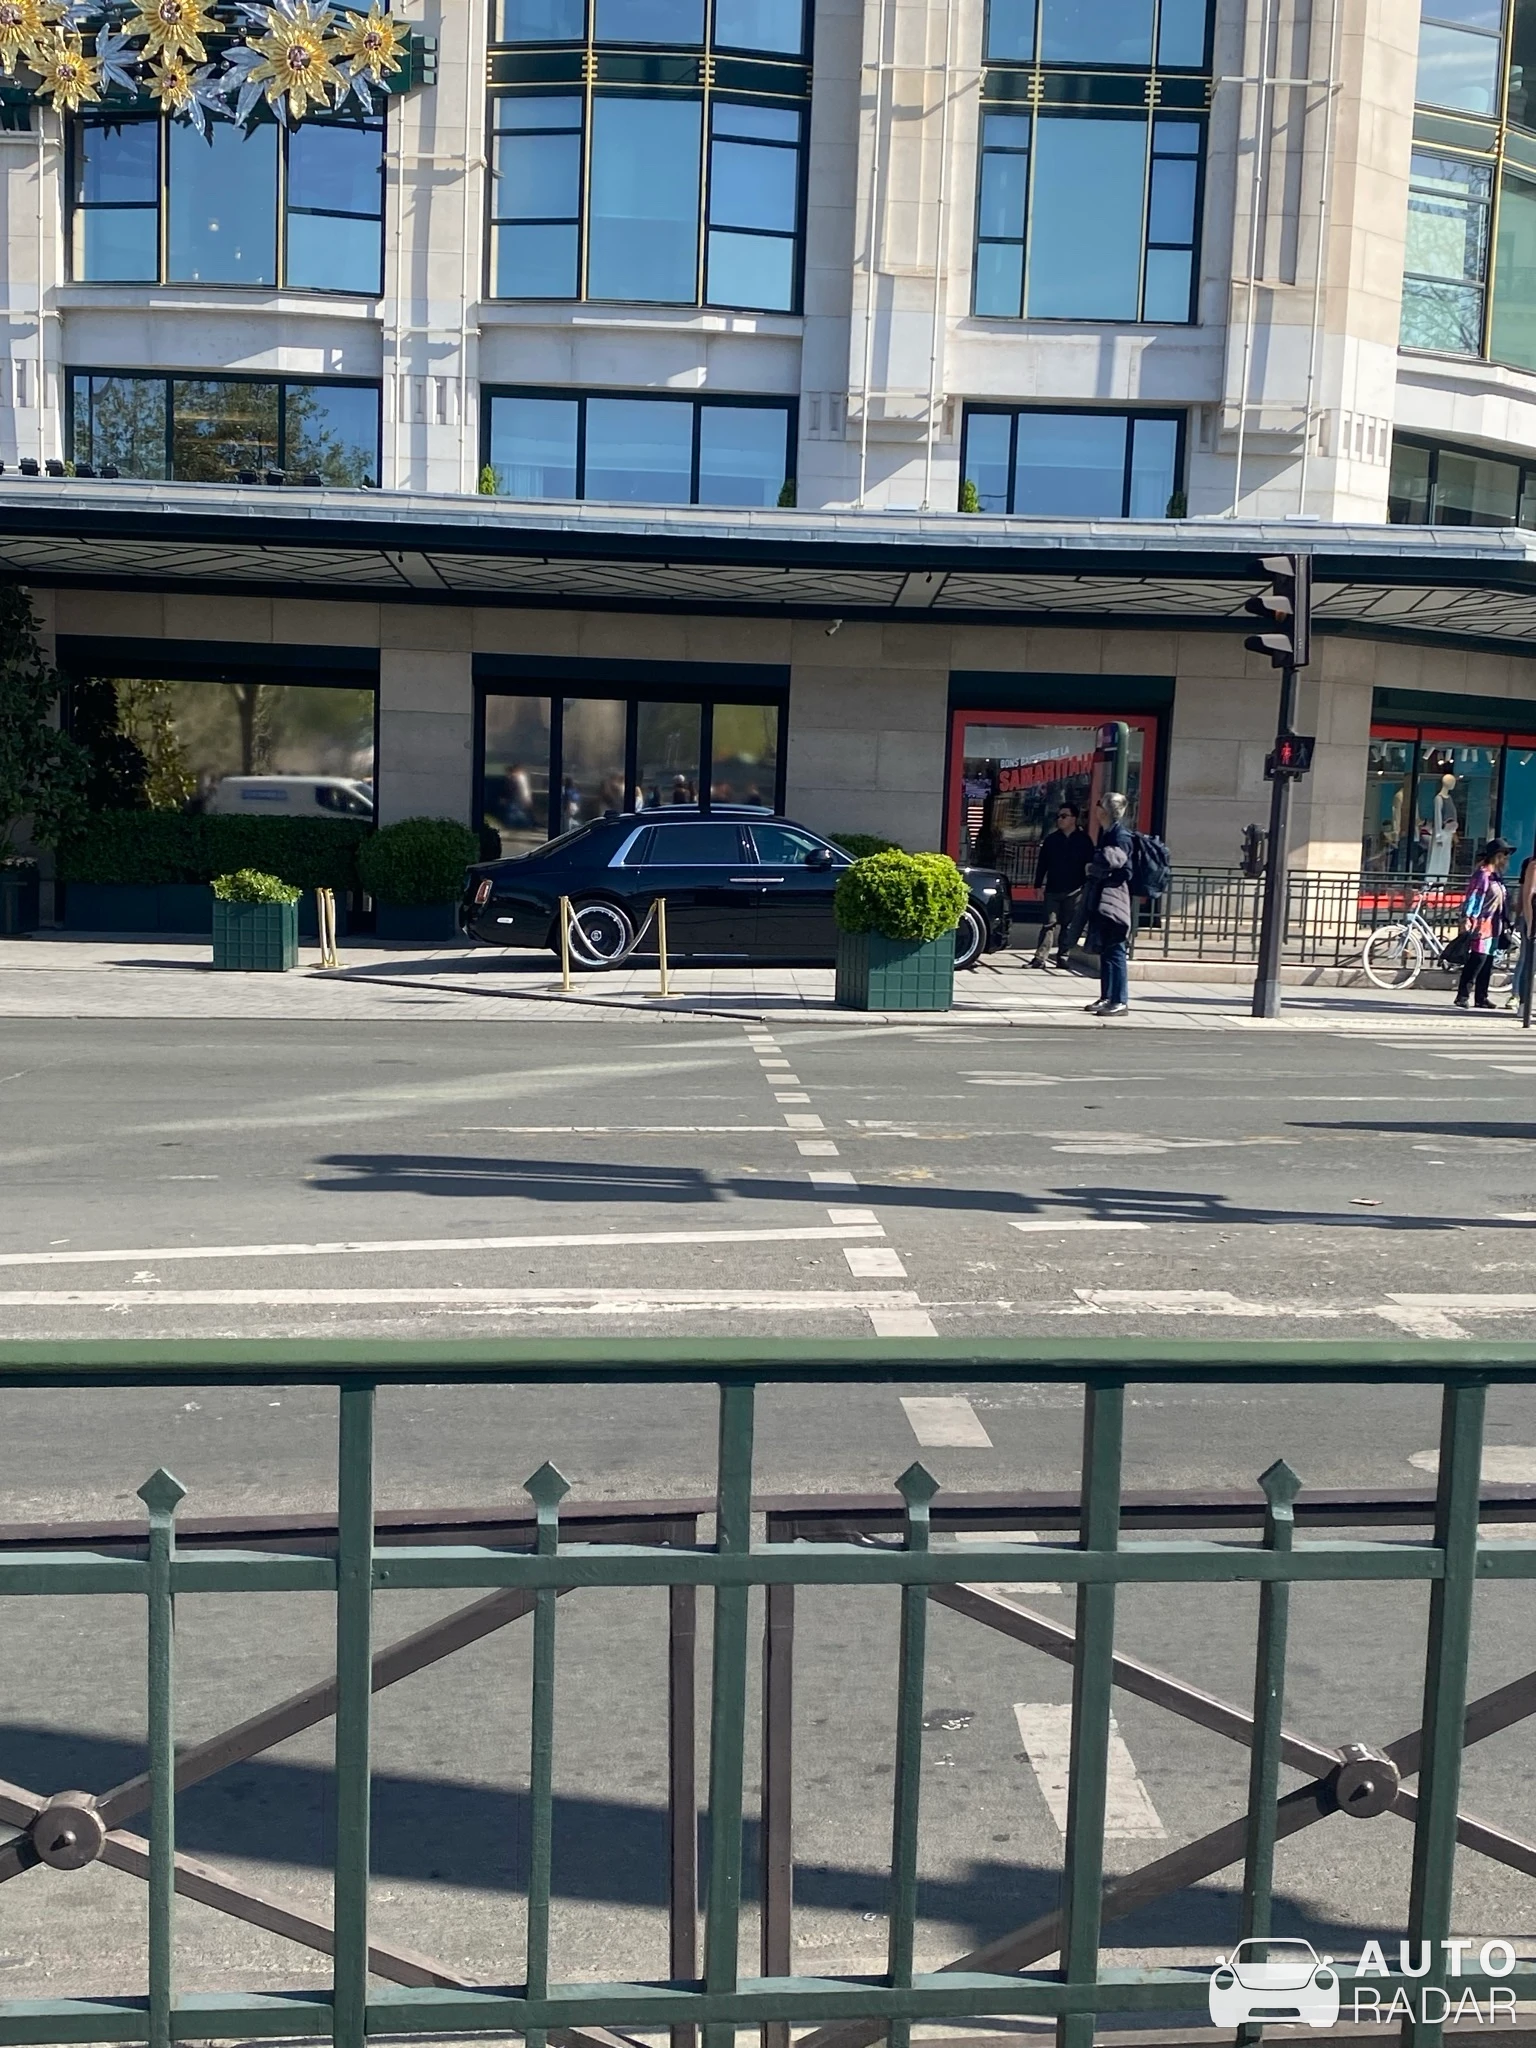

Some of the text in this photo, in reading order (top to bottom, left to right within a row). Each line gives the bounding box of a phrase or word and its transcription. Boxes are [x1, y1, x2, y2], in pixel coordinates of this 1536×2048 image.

[999, 752, 1094, 792] SAMARITAIN
[1000, 758, 1019, 769] BONS
[1050, 748, 1060, 759] DE
[1060, 745, 1070, 755] LA
